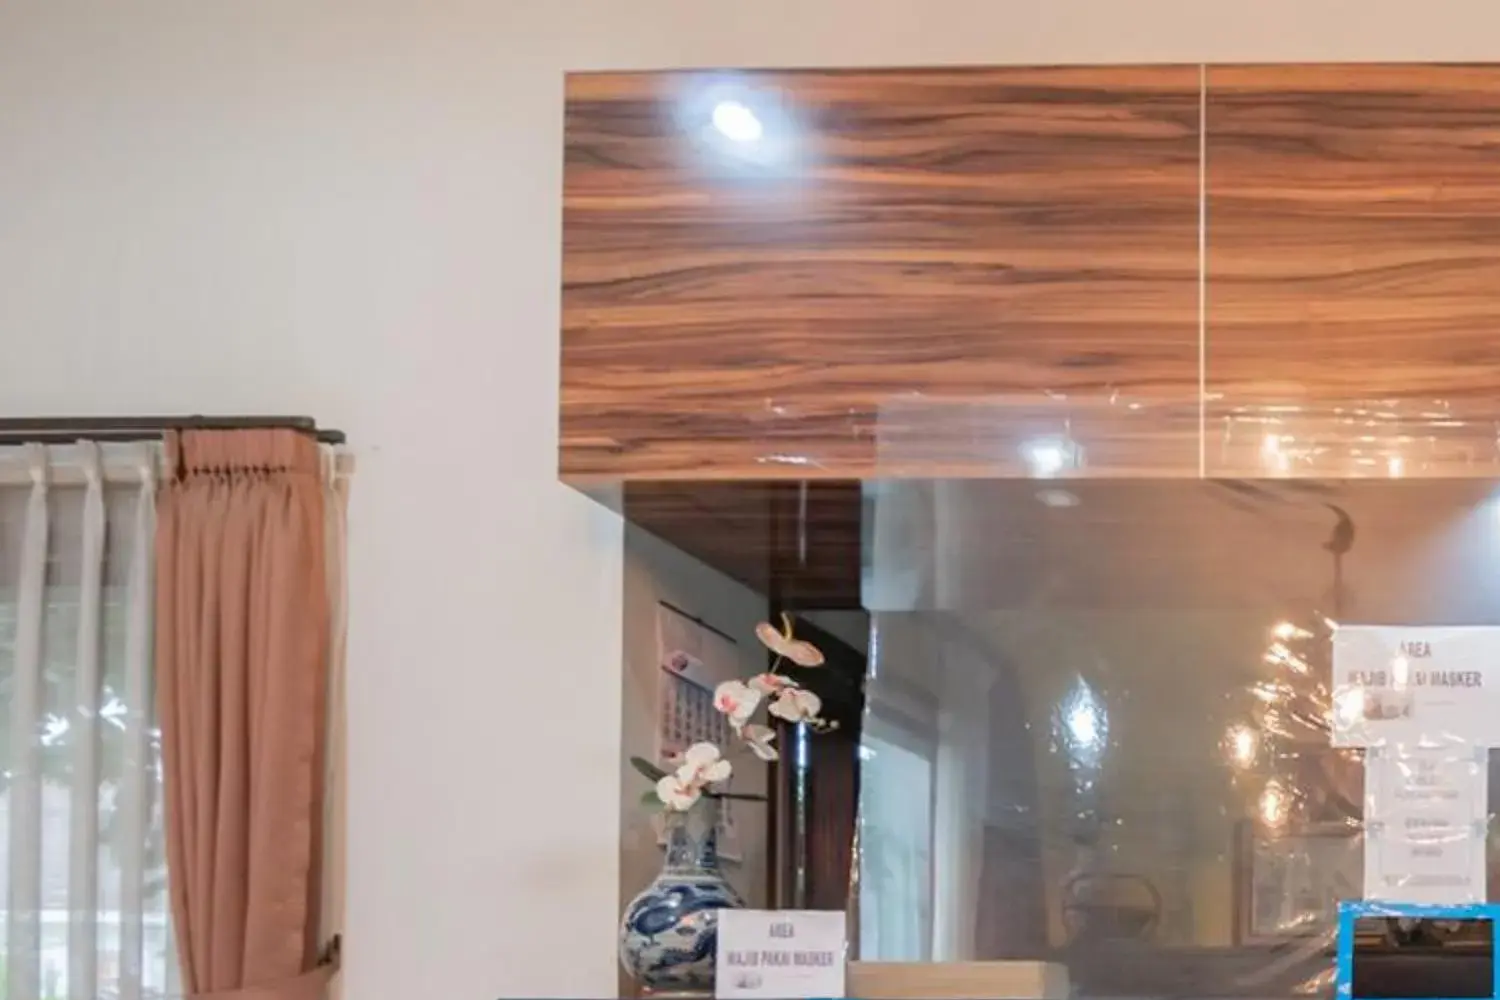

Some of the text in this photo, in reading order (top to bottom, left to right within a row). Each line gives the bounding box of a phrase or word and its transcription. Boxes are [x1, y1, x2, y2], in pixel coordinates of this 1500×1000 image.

[1399, 640, 1432, 659] AREA
[1430, 670, 1483, 688] MASKER
[769, 923, 794, 938] AREA
[794, 951, 834, 967] MASKER
